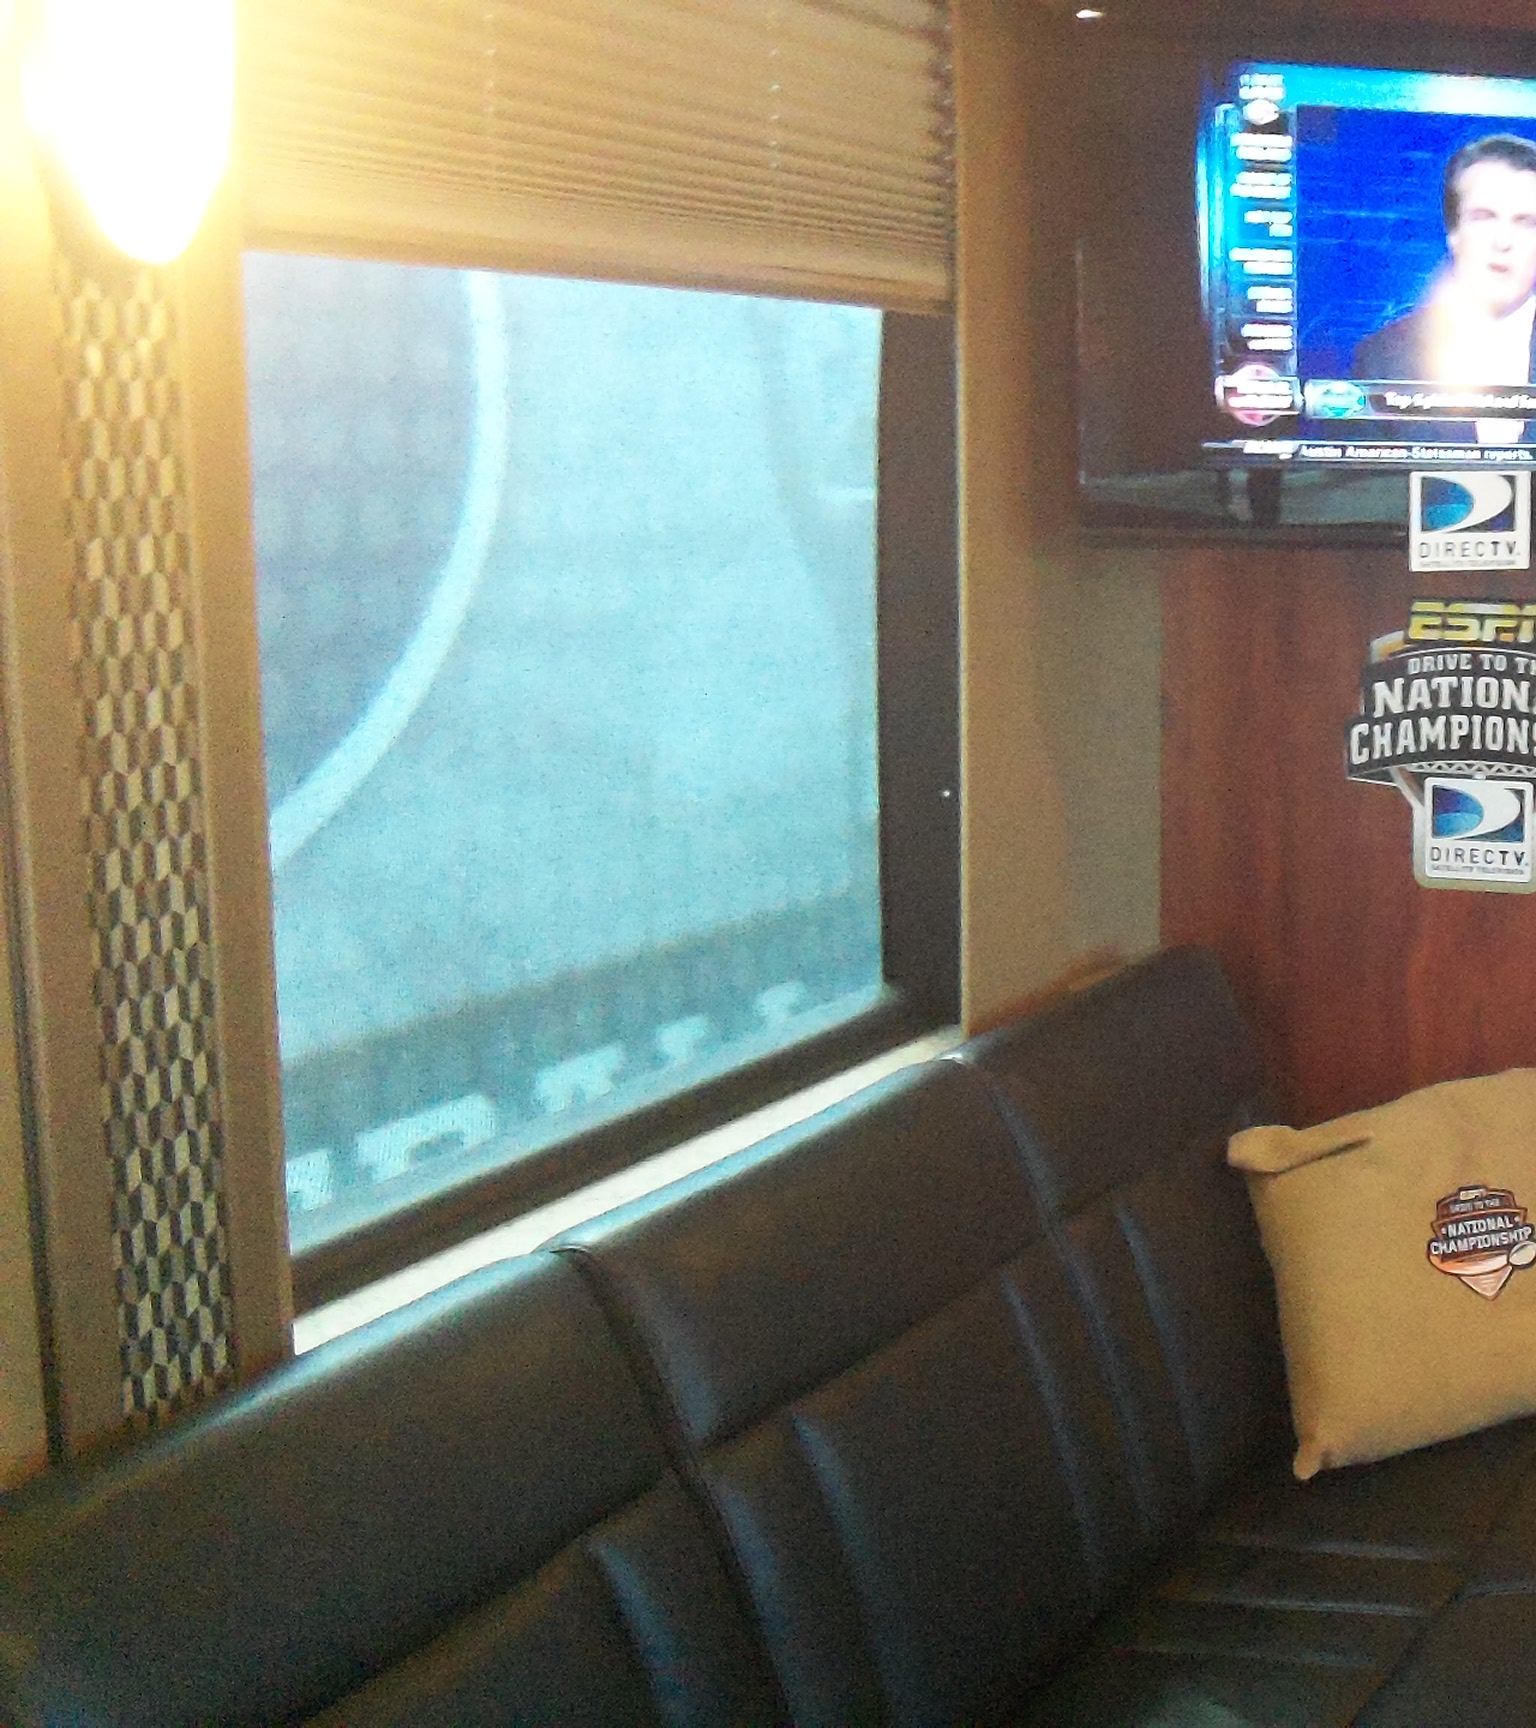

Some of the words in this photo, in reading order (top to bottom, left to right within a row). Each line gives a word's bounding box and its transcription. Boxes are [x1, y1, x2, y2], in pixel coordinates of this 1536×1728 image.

[1419, 540, 1517, 558] DIRECTV
[1407, 653, 1472, 675] DRIVE
[1478, 653, 1508, 672] TO
[1430, 846, 1526, 866] DIRECTV
[1447, 1215, 1514, 1238] NATIONAL
[1430, 1226, 1532, 1255] CHAMPIONSHIP
